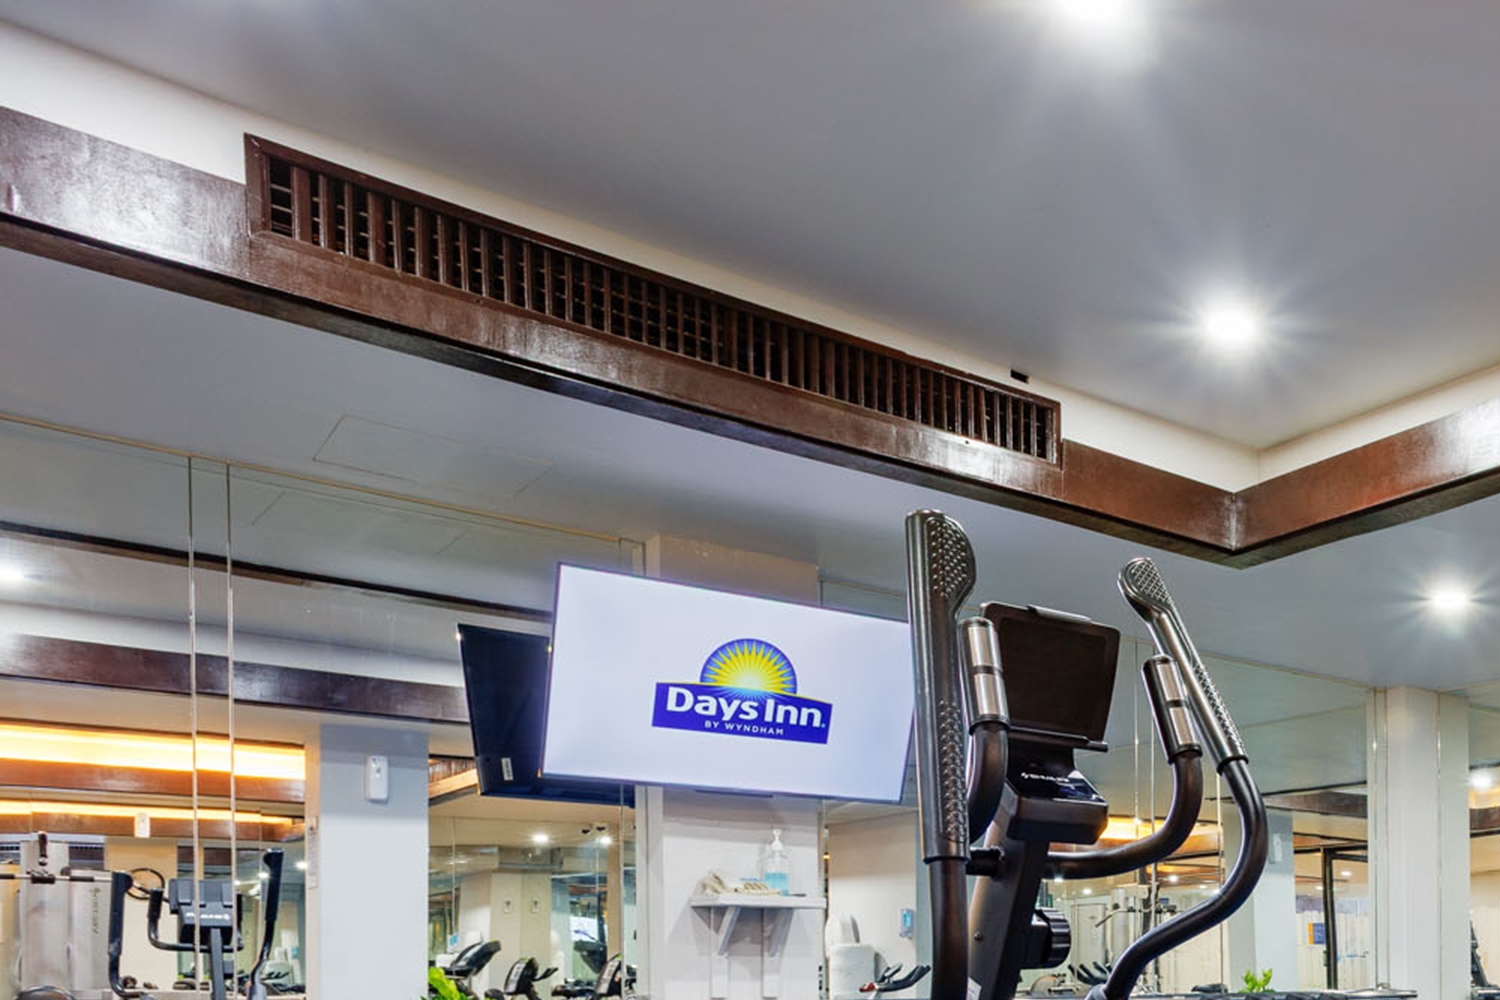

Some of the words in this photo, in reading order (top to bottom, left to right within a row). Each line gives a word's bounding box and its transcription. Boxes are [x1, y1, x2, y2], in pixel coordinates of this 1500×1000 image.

[666, 686, 759, 721] Days
[764, 699, 822, 728] Inn
[705, 720, 720, 728] BY
[725, 722, 784, 735] WYNDHAM
